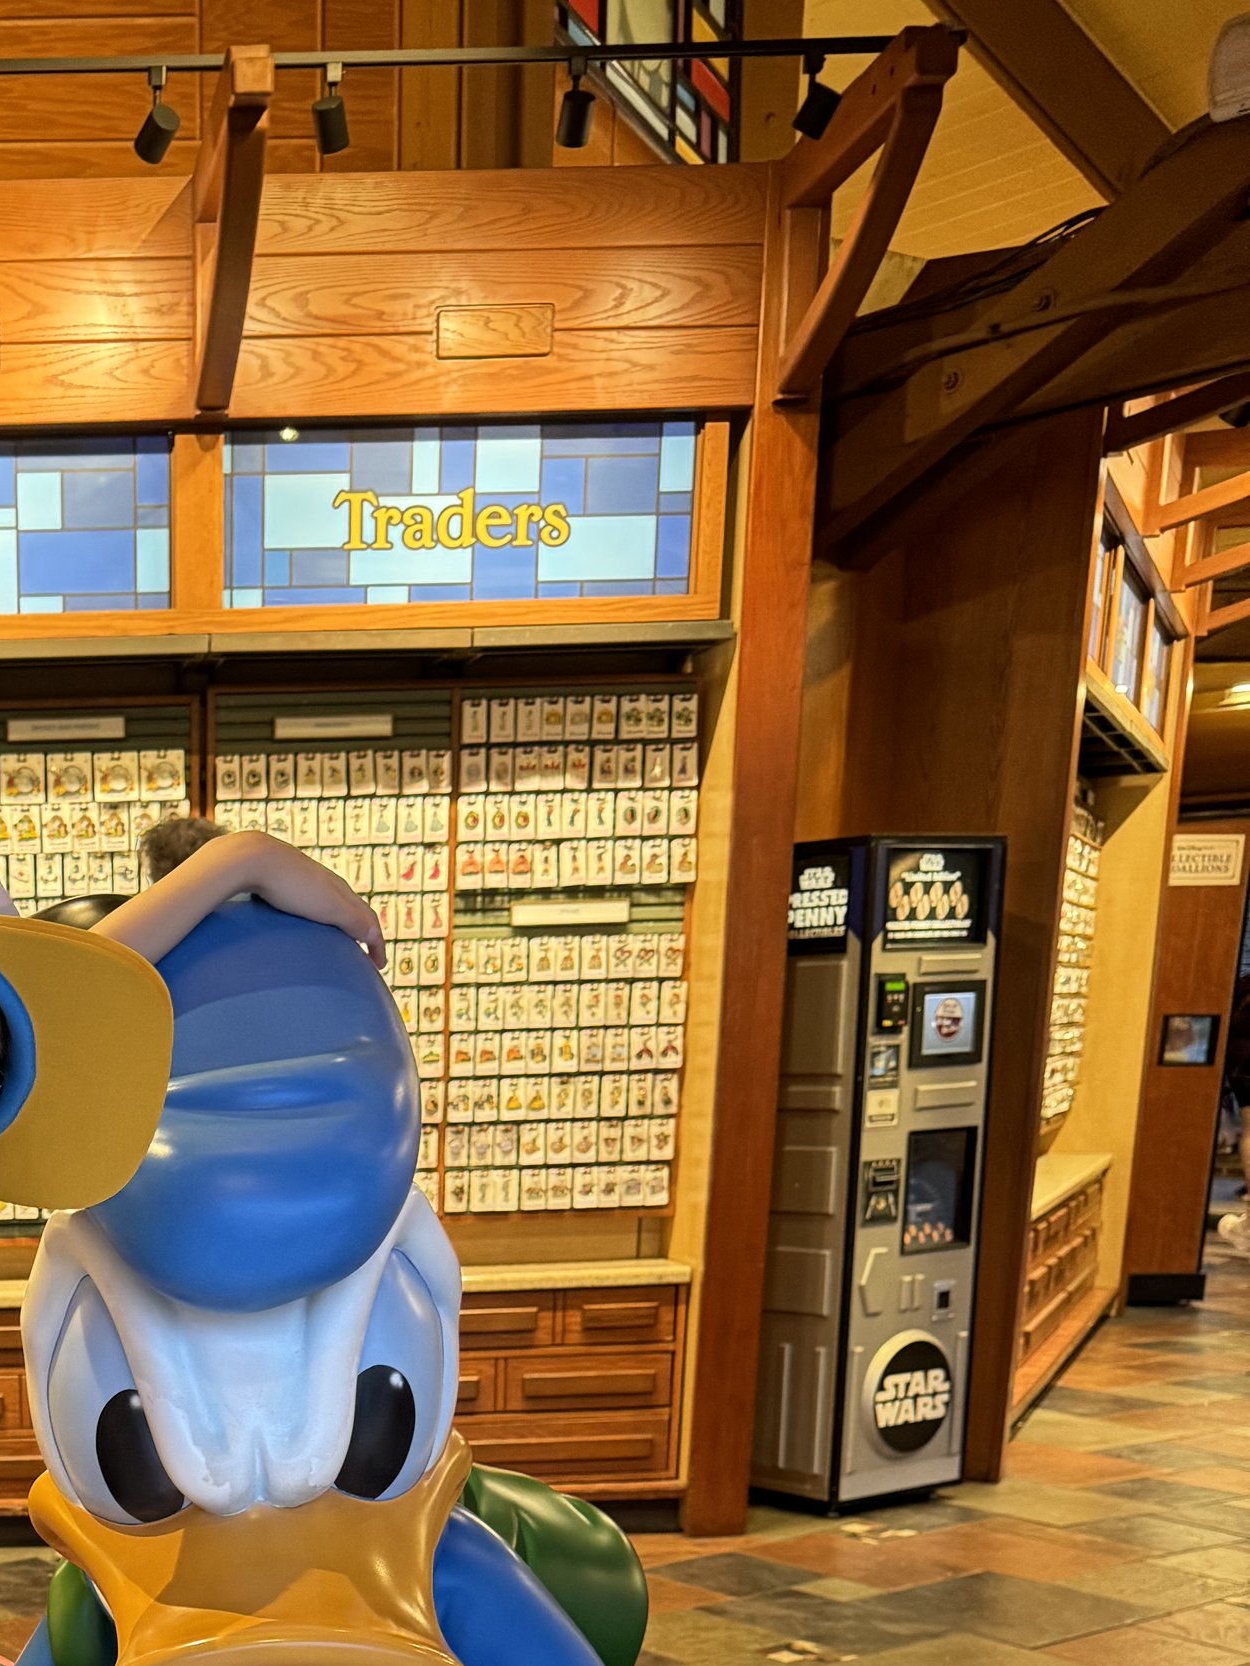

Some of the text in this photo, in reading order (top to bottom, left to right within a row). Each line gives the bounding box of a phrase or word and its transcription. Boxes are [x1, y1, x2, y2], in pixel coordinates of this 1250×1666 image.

[332, 487, 571, 551] Traders
[875, 1367, 950, 1402] STAR
[875, 1393, 949, 1429] WARS
